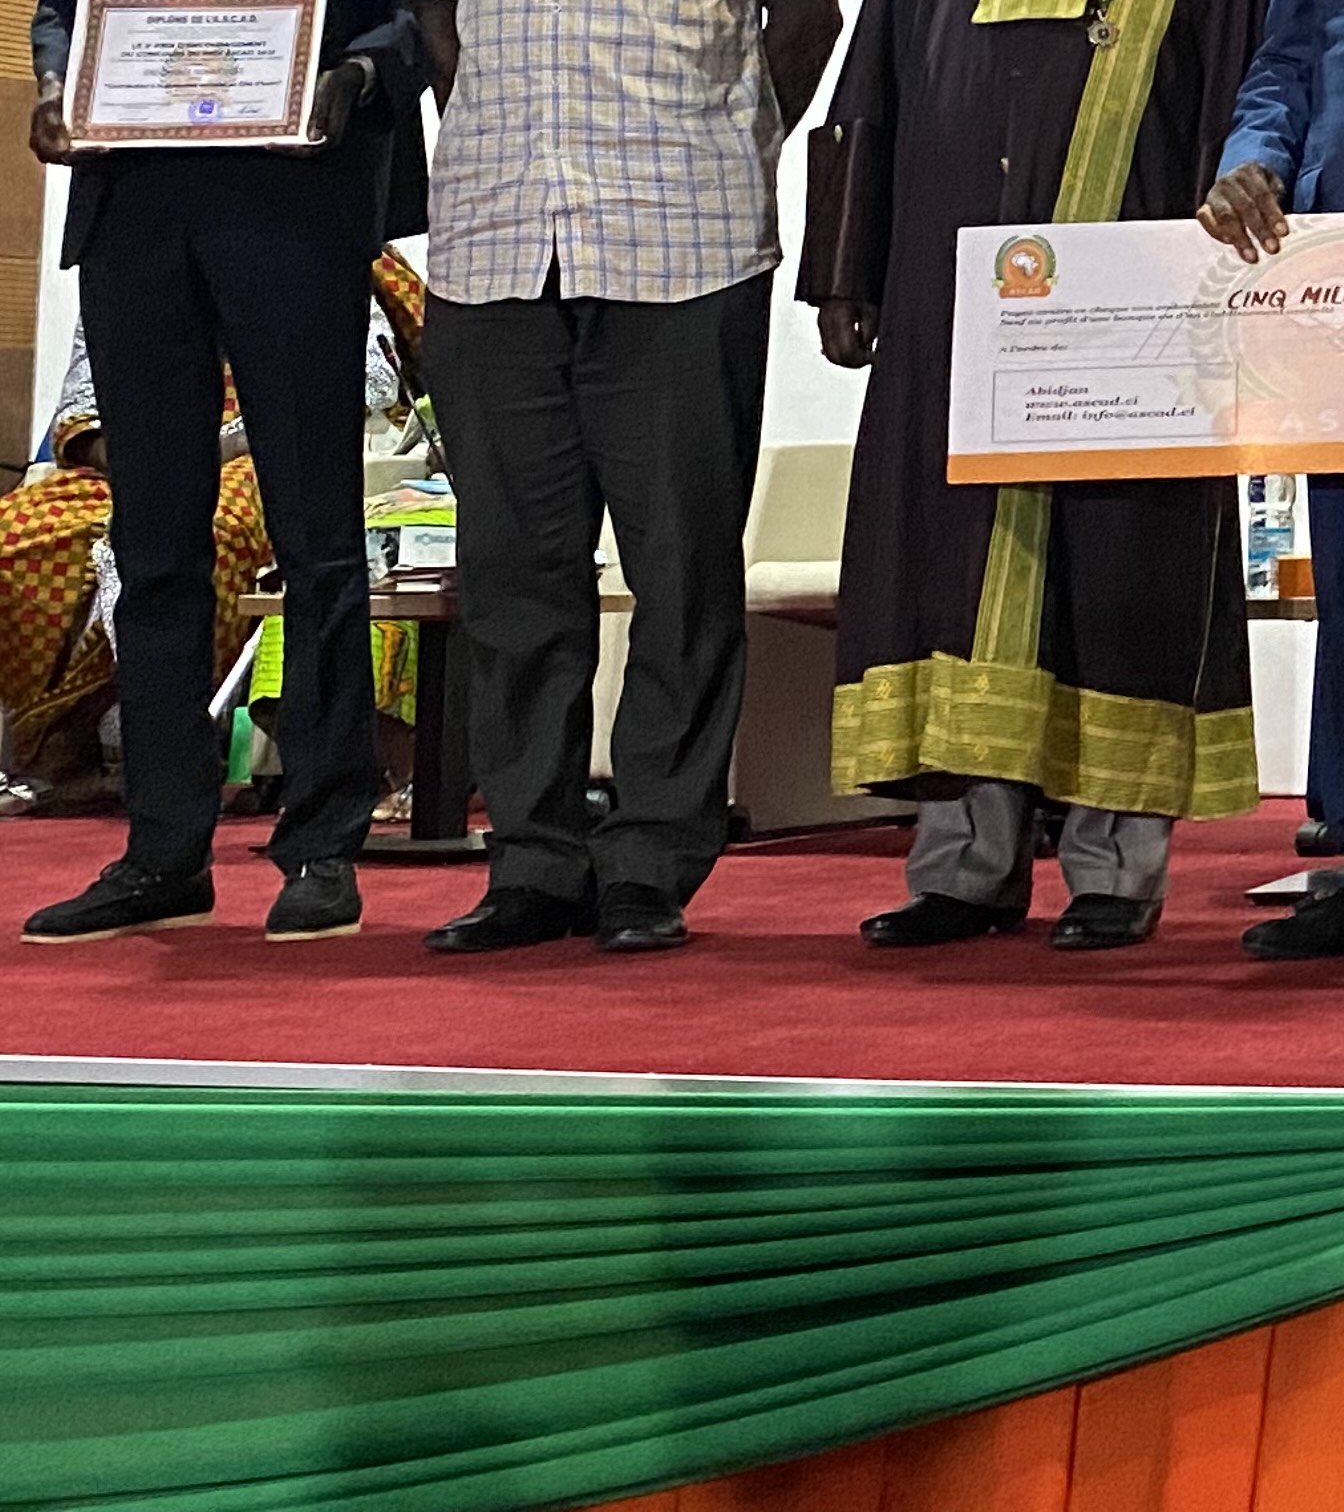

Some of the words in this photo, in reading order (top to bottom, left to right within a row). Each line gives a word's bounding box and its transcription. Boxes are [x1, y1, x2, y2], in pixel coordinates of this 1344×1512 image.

[1227, 288, 1287, 310] CINQ
[1025, 385, 1089, 397] Abidjan
[1025, 395, 1138, 409] www.ascad.ci
[1025, 411, 1077, 422] Email:
[1082, 406, 1196, 421] info@ascad.ci
